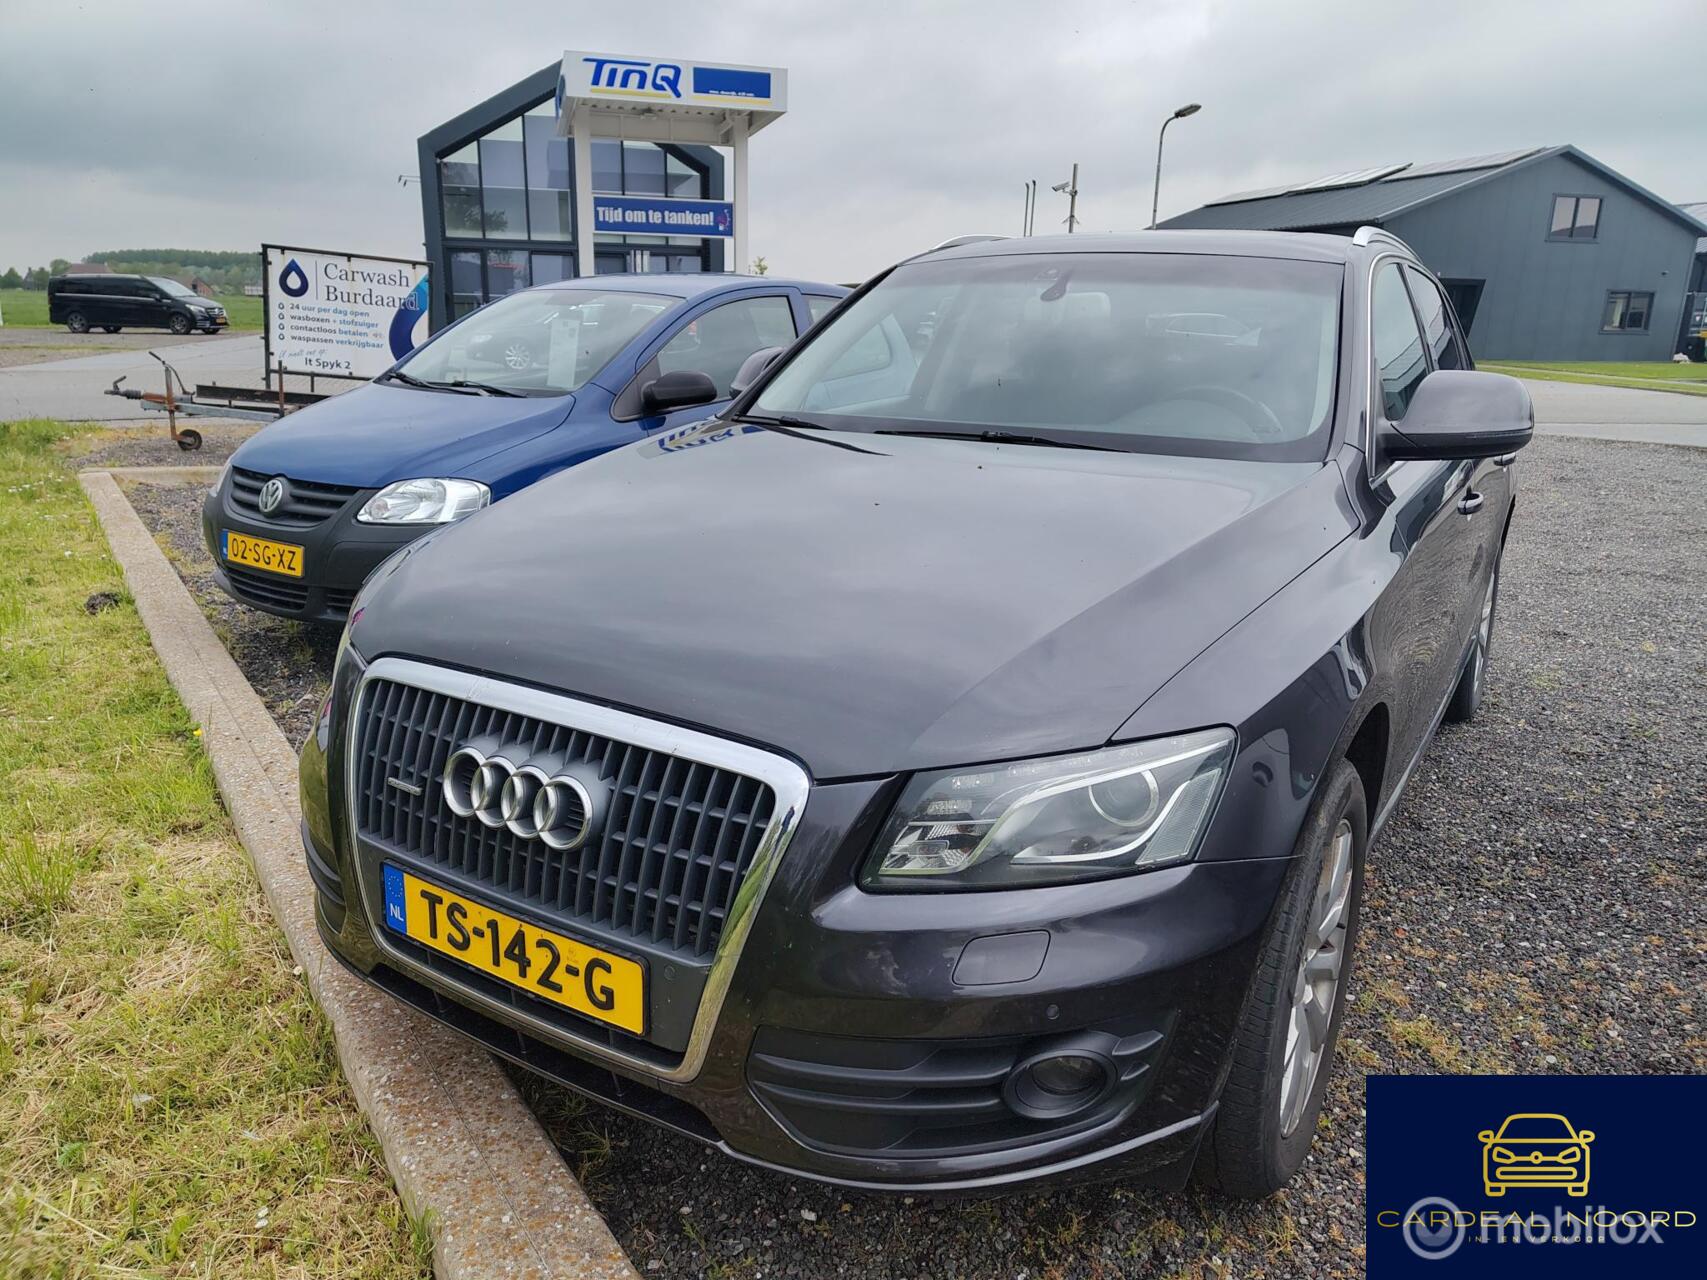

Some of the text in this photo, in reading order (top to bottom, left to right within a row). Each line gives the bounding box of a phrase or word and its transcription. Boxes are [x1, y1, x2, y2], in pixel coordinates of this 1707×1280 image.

[596, 206, 714, 226] Tijd om te tanken!
[324, 263, 410, 287] Carwash
[325, 285, 420, 311] Burdaard
[290, 314, 330, 323] wasboxen
[339, 319, 379, 329] stofzuiger
[317, 306, 331, 314] per
[332, 307, 348, 316] dag
[349, 310, 370, 318] open
[290, 324, 337, 334] contactloos
[338, 327, 369, 337] betalen
[290, 335, 384, 349] waspassen verkrijgbaar
[315, 358, 342, 370] Spyk
[344, 360, 351, 369] 2
[231, 538, 297, 571] 02-SG-XZ
[389, 903, 404, 922] NL
[420, 889, 615, 1011] TS-142-G
